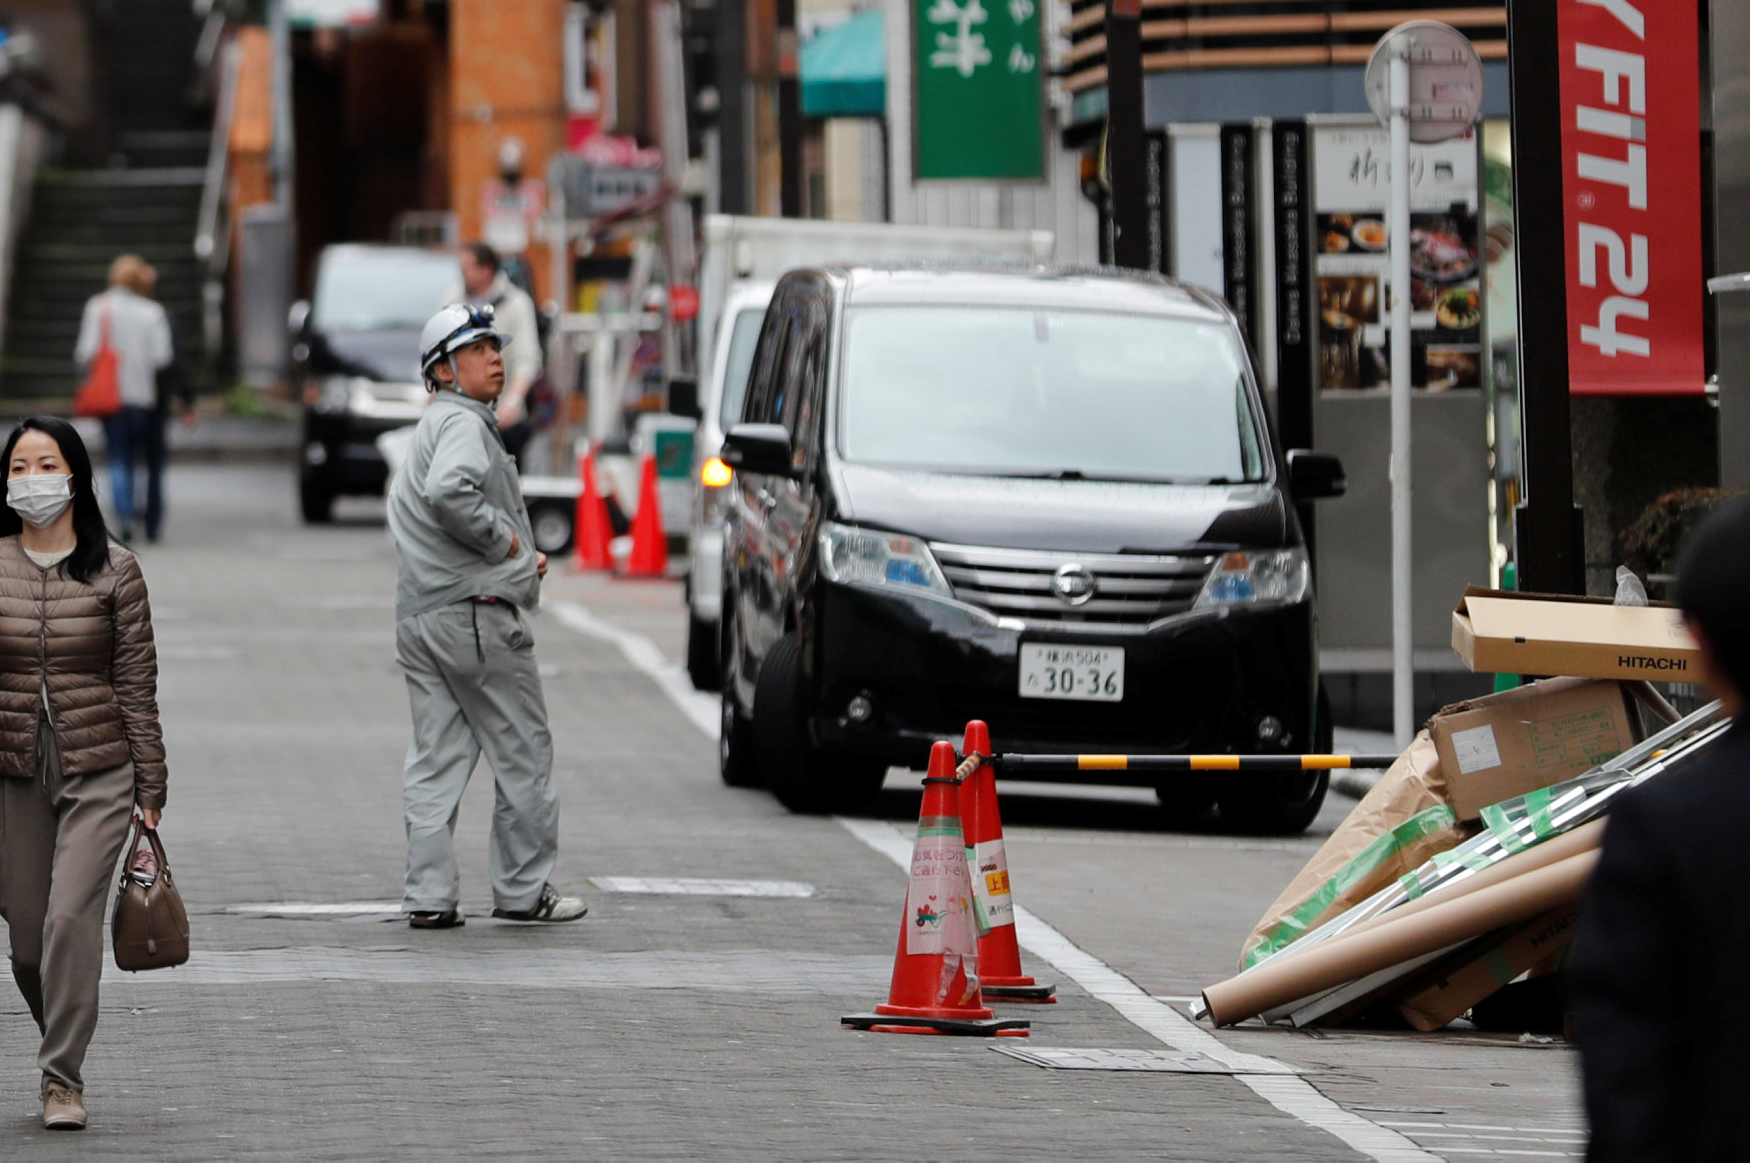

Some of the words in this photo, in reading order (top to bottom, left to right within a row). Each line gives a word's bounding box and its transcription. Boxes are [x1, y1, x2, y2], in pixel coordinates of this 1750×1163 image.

[1228, 133, 1245, 207] Building
[1282, 131, 1299, 207] Building
[1283, 208, 1300, 286] Akasaka
[1284, 288, 1301, 345] Daiwa
[1578, 222, 1650, 358] 24
[1043, 667, 1118, 696] 30-36
[1617, 656, 1688, 671] HITACHI
